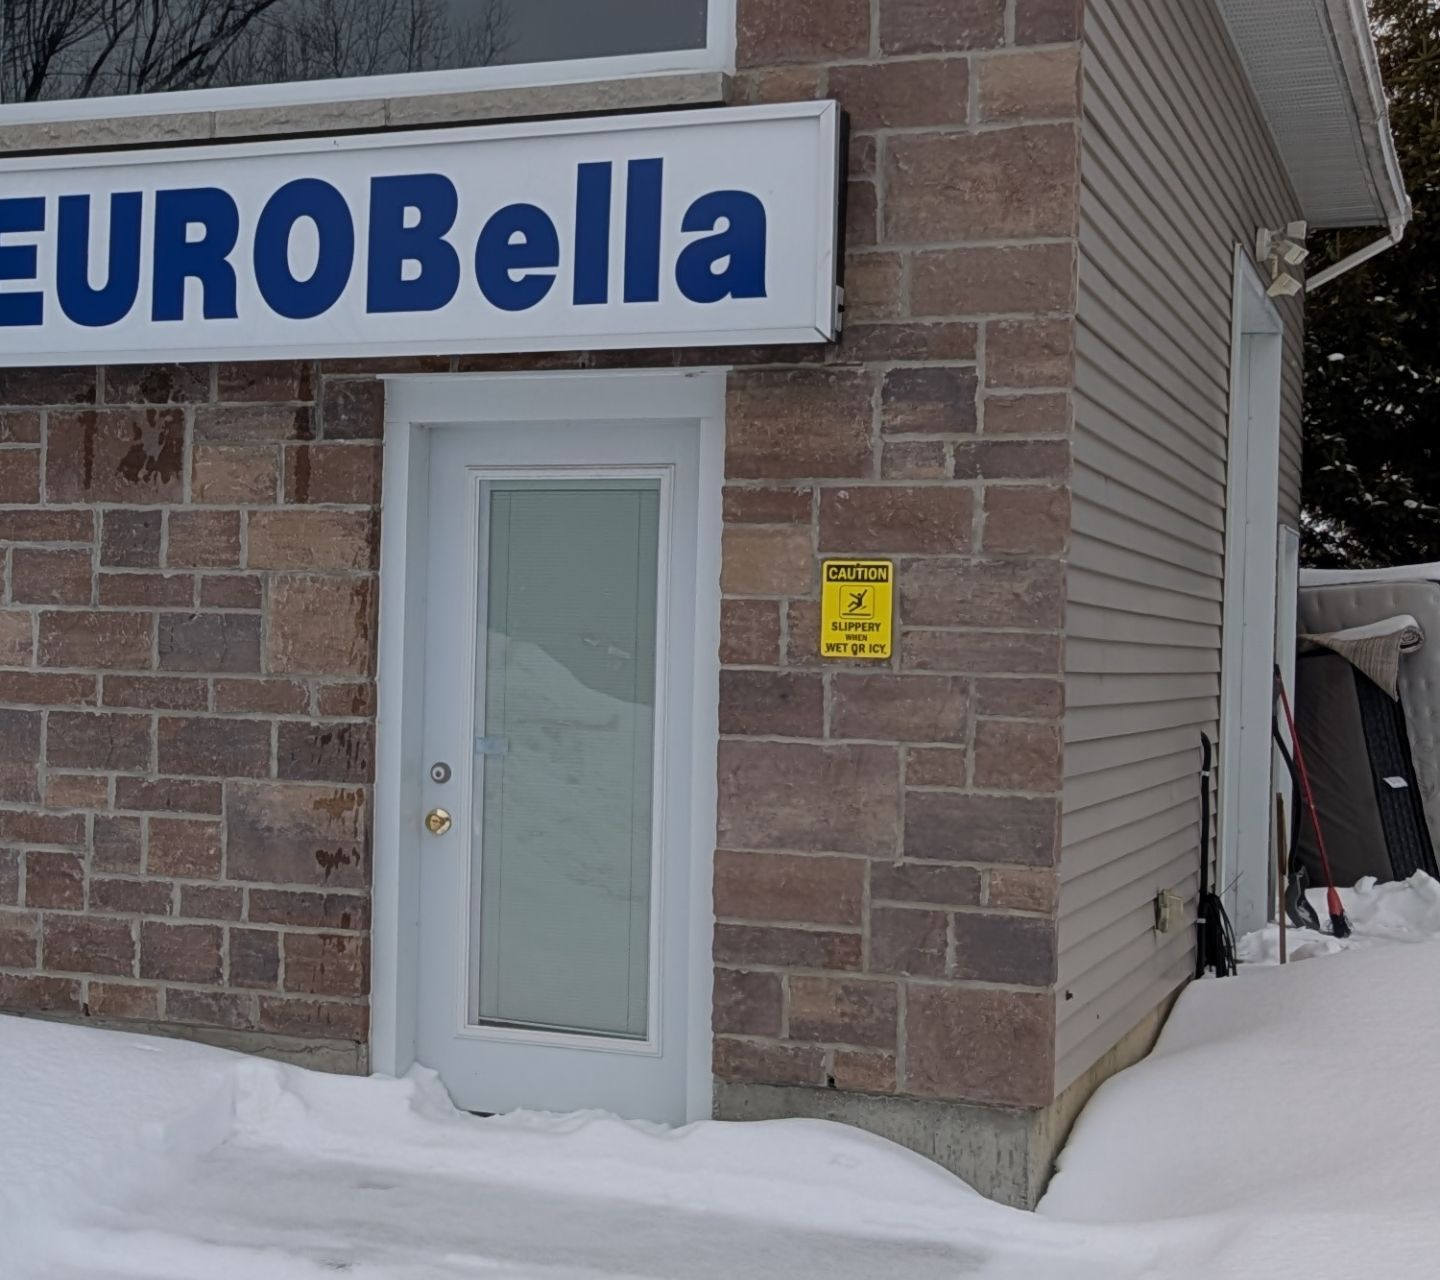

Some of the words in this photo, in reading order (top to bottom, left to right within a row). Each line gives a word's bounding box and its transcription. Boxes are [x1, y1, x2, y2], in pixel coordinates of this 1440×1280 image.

[828, 567, 887, 580] CAUTION
[831, 621, 881, 632] SLIPPERY
[845, 633, 868, 642] WHEN
[825, 642, 848, 653] WET
[851, 643, 865, 653] OR
[869, 643, 886, 654] ICY
